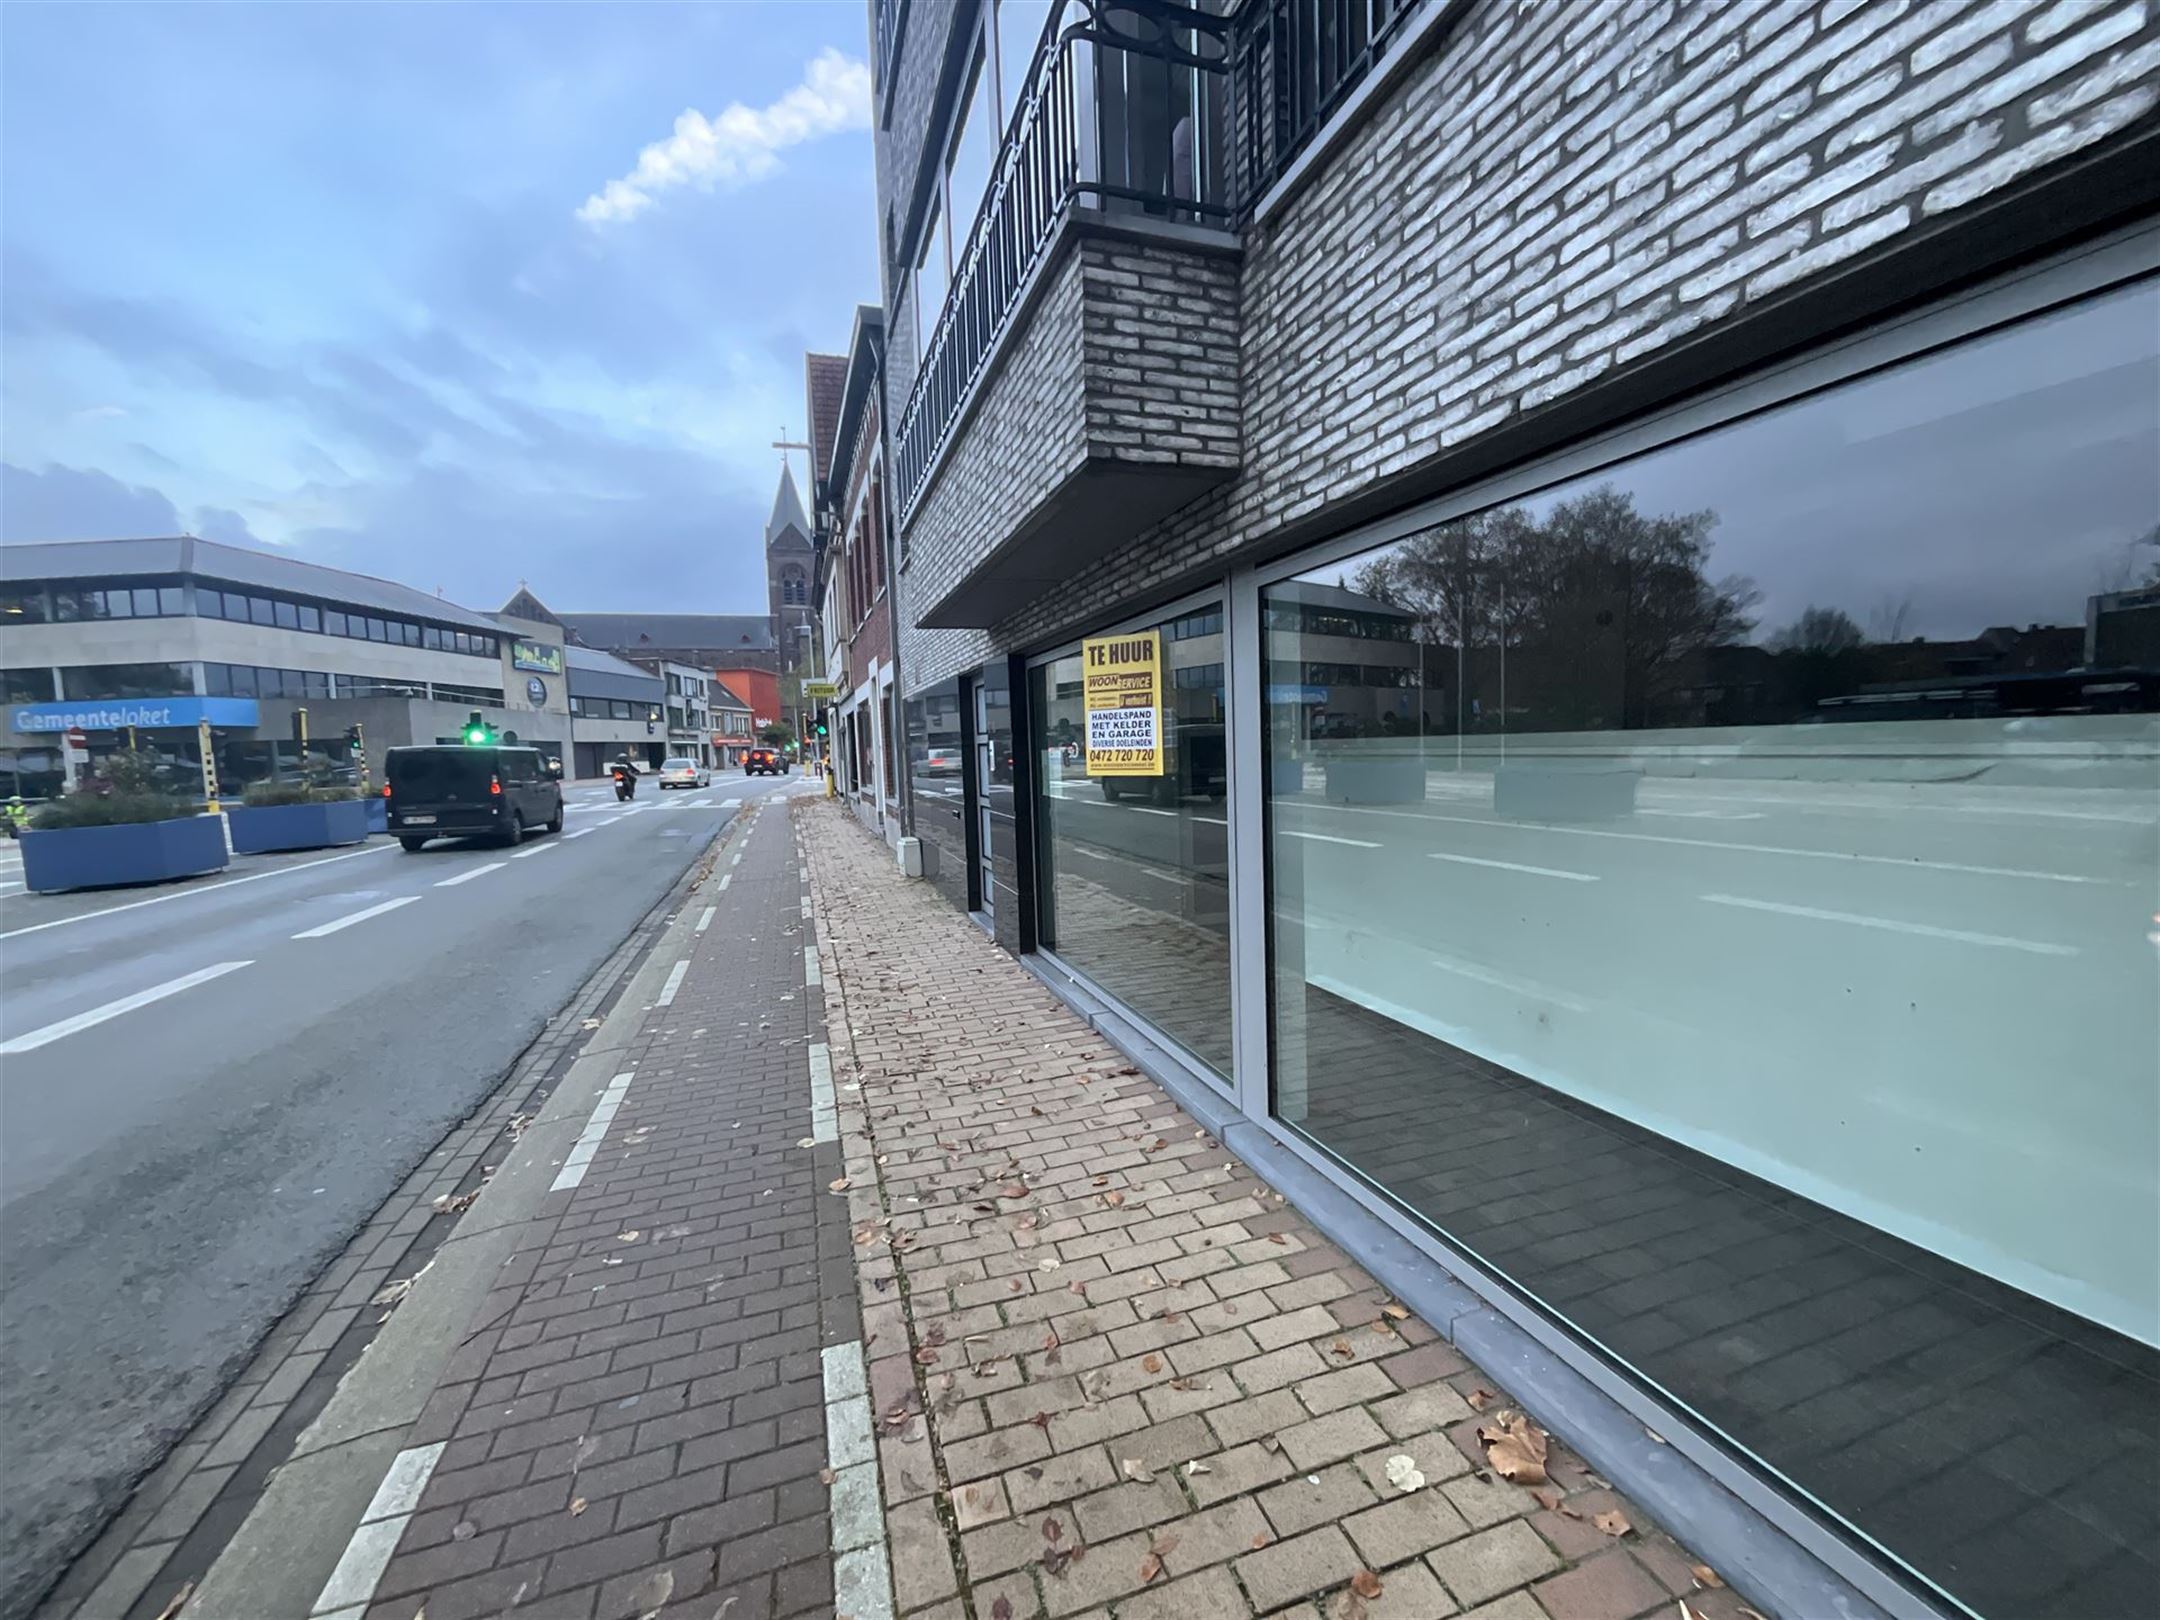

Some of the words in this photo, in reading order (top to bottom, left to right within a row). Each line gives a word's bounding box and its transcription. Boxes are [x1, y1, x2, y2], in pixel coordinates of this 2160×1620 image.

[1088, 644, 1106, 666] TE
[1109, 640, 1153, 665] HUUR
[1089, 676, 1118, 688] WOON
[16, 706, 171, 729] Gemeenteloket
[1091, 710, 1152, 721] HANDELSPAND
[1092, 721, 1110, 730] MET
[1113, 720, 1151, 730] KELDER
[1092, 730, 1105, 739] EN
[1108, 729, 1152, 738] GARAGE
[1092, 739, 1115, 748] DIVERSE
[1116, 738, 1152, 747] DOELEINDEN
[1090, 750, 1113, 762] 0472
[1115, 749, 1133, 761] 720
[1136, 749, 1154, 761] 720
